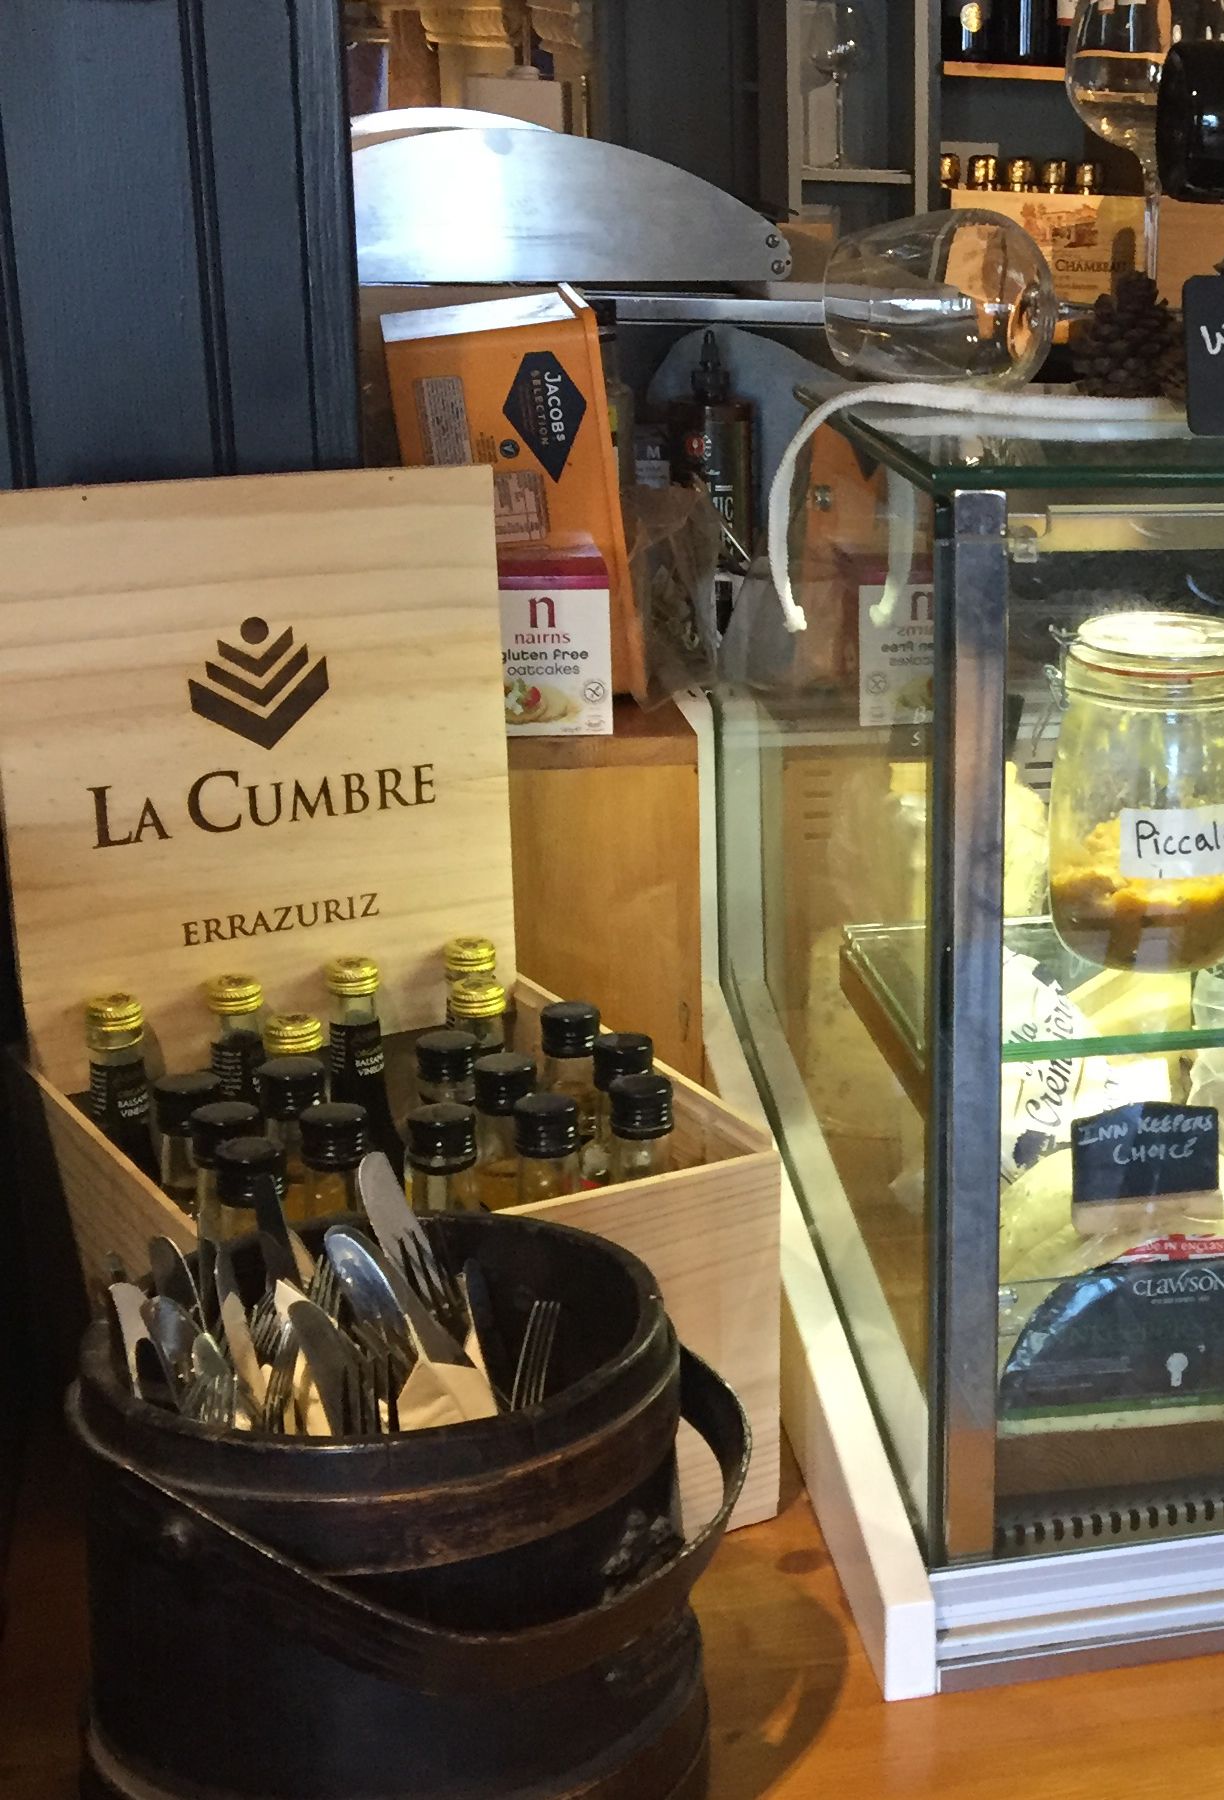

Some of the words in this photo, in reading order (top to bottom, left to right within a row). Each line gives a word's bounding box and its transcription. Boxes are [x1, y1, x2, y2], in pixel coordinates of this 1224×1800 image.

[530, 370, 549, 445] SELECTION
[544, 371, 566, 442] JACOBS
[514, 632, 572, 644] nairns
[502, 648, 548, 664] gluten
[553, 648, 589, 660] free
[507, 662, 581, 676] oatcakes
[87, 784, 174, 849] LA
[187, 763, 437, 834] CUMBRE
[182, 892, 380, 946] ERRAZURIZ
[1137, 1113, 1213, 1134] KEEPERS
[1113, 1137, 1198, 1165] CHOICE
